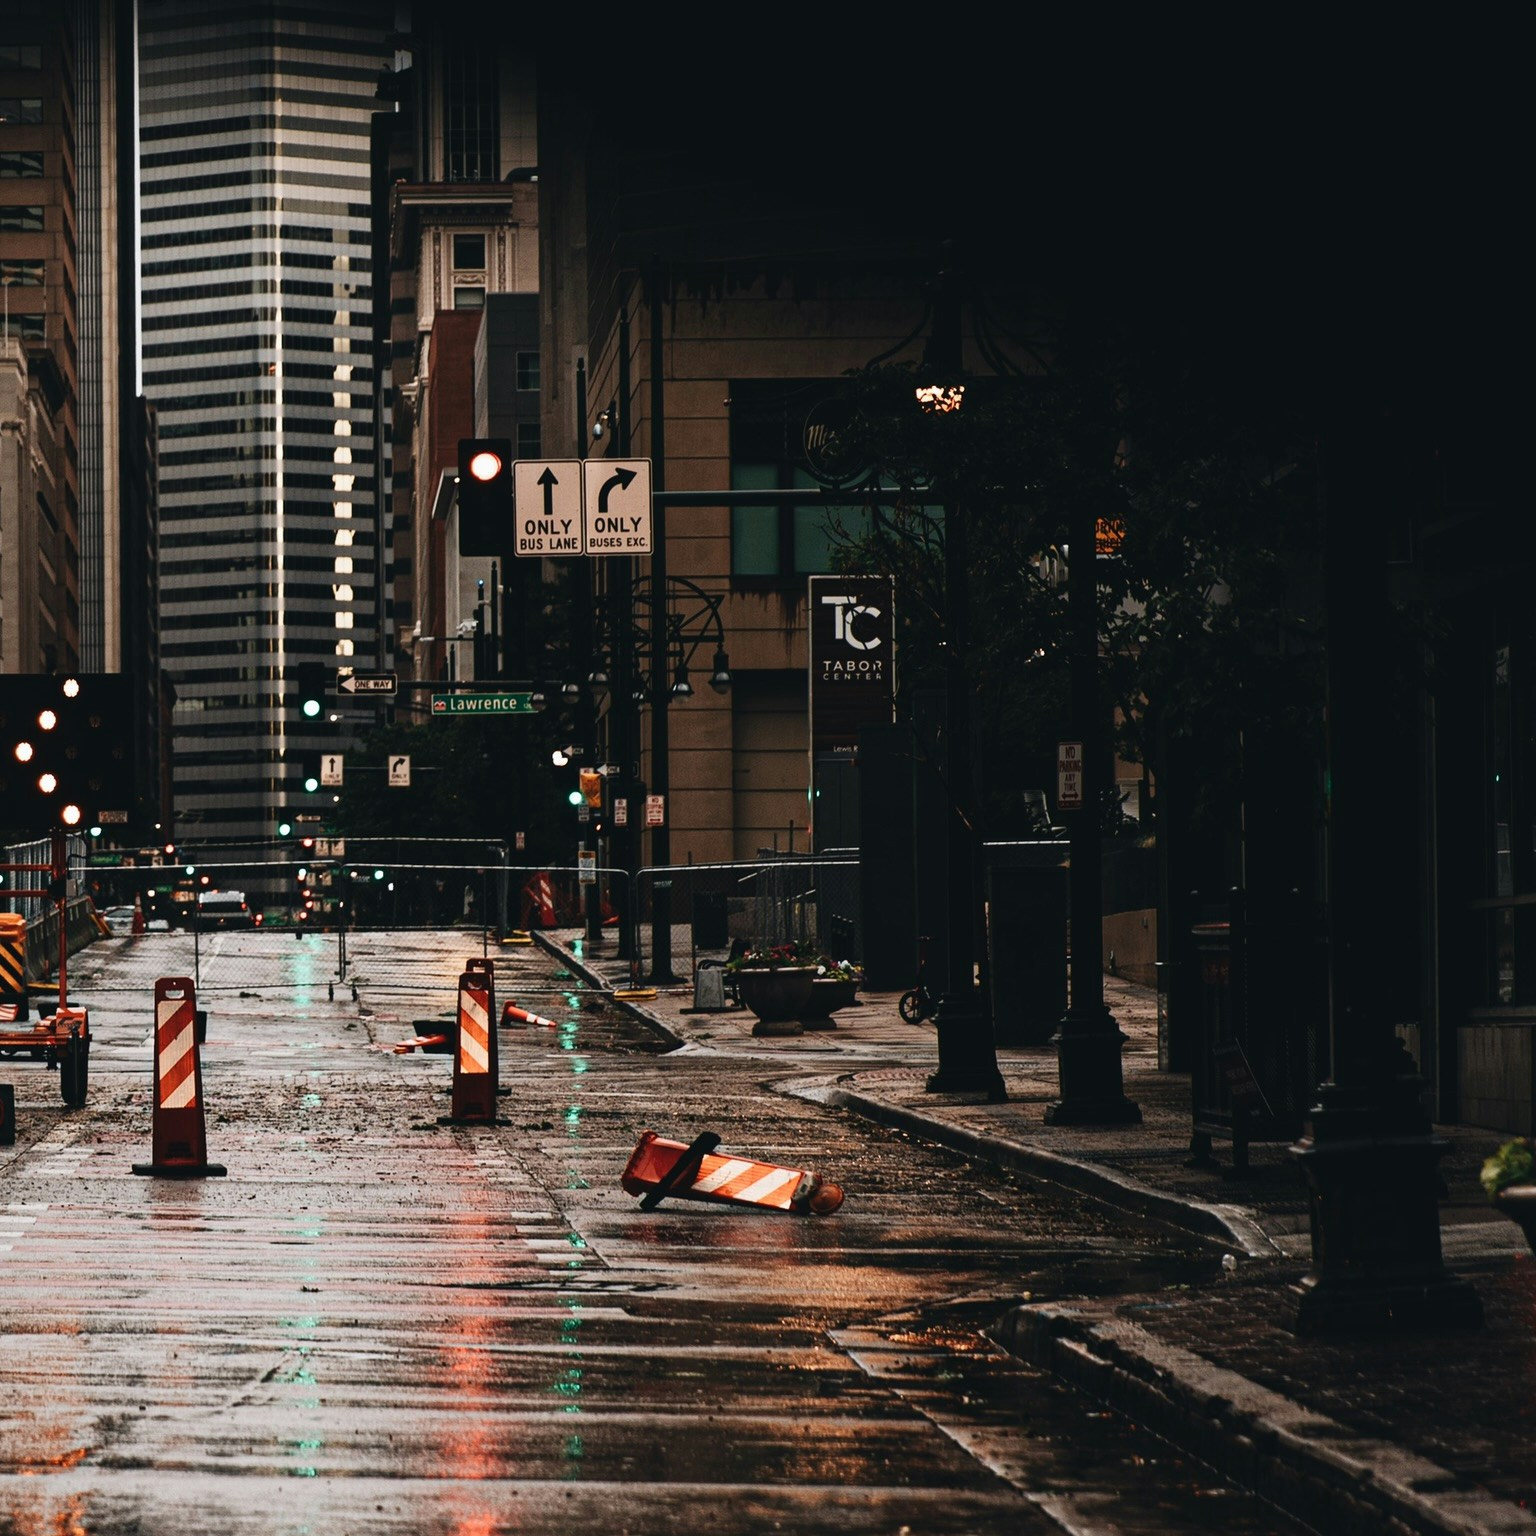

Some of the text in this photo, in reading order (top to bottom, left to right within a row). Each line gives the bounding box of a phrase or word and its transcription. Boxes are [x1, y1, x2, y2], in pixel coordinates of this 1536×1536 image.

[525, 519, 572, 535] ONLY
[595, 517, 642, 533] ONLY
[520, 537, 578, 550] BUS LANE
[589, 537, 648, 547] BUSES EXC.
[821, 595, 882, 651] TC
[822, 660, 883, 672] TABOR
[822, 672, 883, 681] CENTER
[354, 680, 390, 689] ONE WAY
[450, 696, 517, 711] Lawrence
[1065, 746, 1076, 759] NO
[1059, 760, 1082, 773] PARKING
[1064, 774, 1075, 782] ANY
[1064, 783, 1076, 792] TIME
